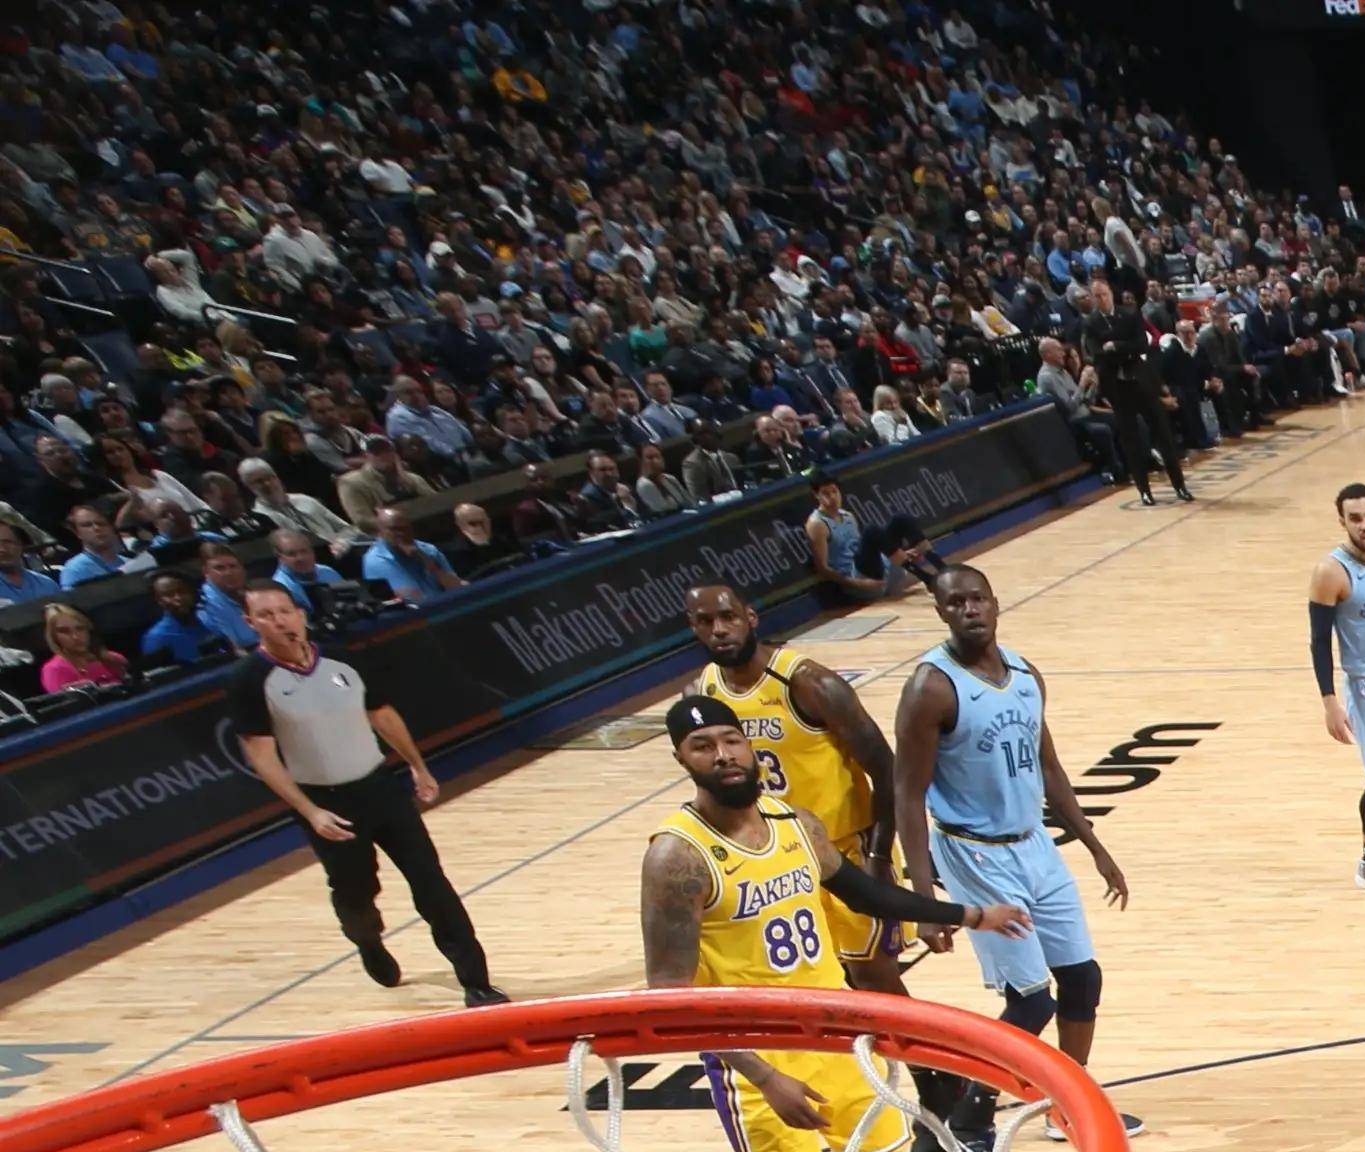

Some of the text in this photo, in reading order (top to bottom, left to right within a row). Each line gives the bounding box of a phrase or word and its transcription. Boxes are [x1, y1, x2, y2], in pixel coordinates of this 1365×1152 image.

[872, 484, 936, 518] Every
[920, 467, 968, 507] Day
[491, 599, 624, 674] Making
[699, 536, 791, 590] People
[739, 716, 785, 741] ERS
[976, 708, 1040, 754] GRIZZLIE
[753, 748, 790, 793] 3
[1000, 737, 1034, 778] 14
[730, 865, 814, 921] LAKERS
[764, 906, 821, 970] 88
